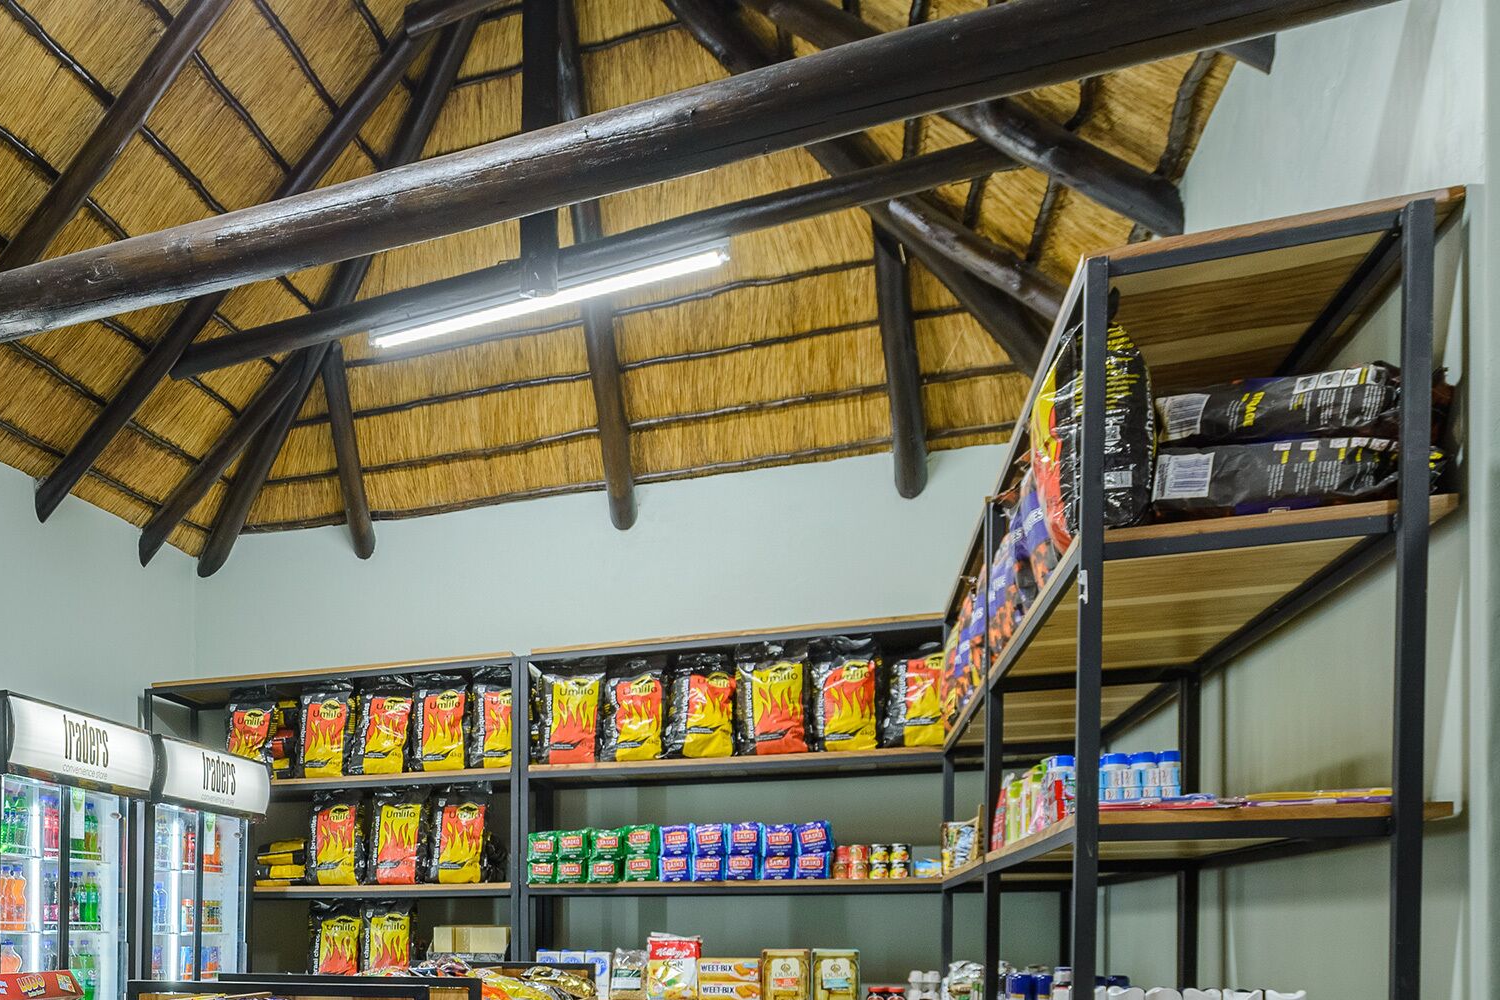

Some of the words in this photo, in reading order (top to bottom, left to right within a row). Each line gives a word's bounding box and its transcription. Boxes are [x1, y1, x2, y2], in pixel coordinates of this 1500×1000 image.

[760, 672, 798, 681] Umlilo
[560, 687, 594, 696] Umlilo
[429, 701, 460, 710] Umlilo
[312, 708, 343, 720] Umlilo
[63, 713, 109, 768] traders
[62, 763, 94, 778] convenience
[95, 768, 108, 781] store
[201, 751, 237, 797] traders
[322, 811, 352, 821] Umlilo
[386, 809, 416, 819] Umlilo
[701, 964, 733, 972] WEET-BIX
[16, 974, 46, 993] LUDO
[702, 986, 735, 994] WEET-BIX
